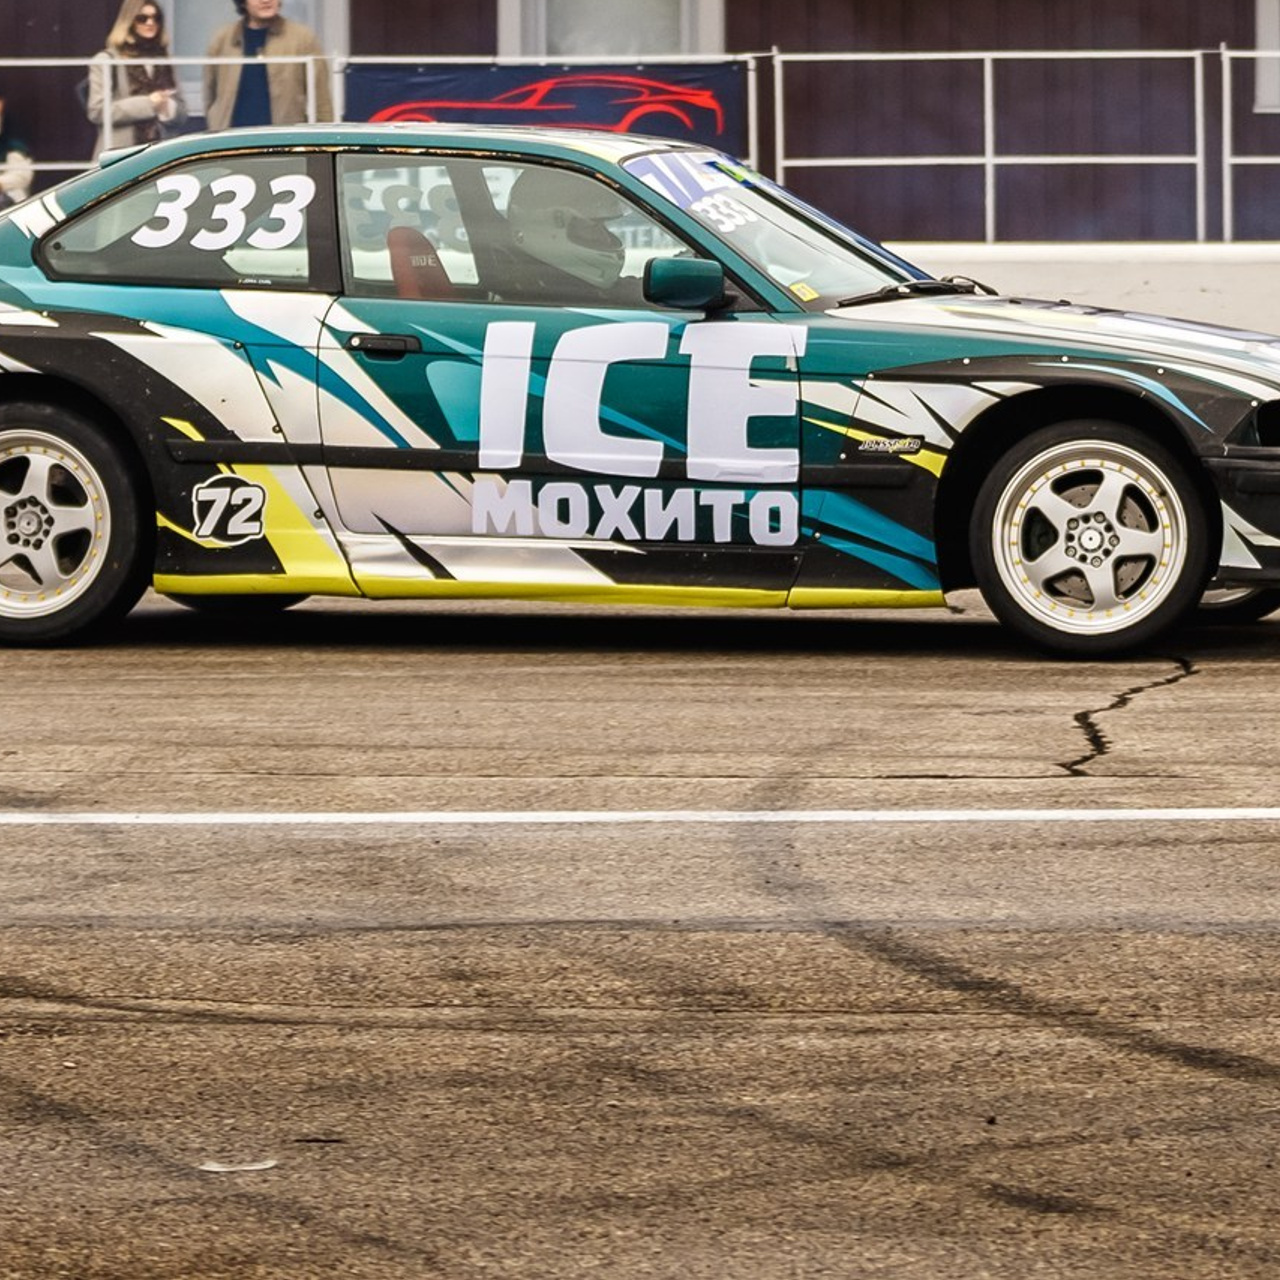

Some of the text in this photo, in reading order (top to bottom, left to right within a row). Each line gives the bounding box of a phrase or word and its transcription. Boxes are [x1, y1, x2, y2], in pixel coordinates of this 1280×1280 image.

[131, 174, 316, 251] 333
[690, 192, 758, 234] 333
[478, 321, 809, 484] ICE
[193, 485, 265, 535] 72
[471, 478, 800, 547] МОХИТО
